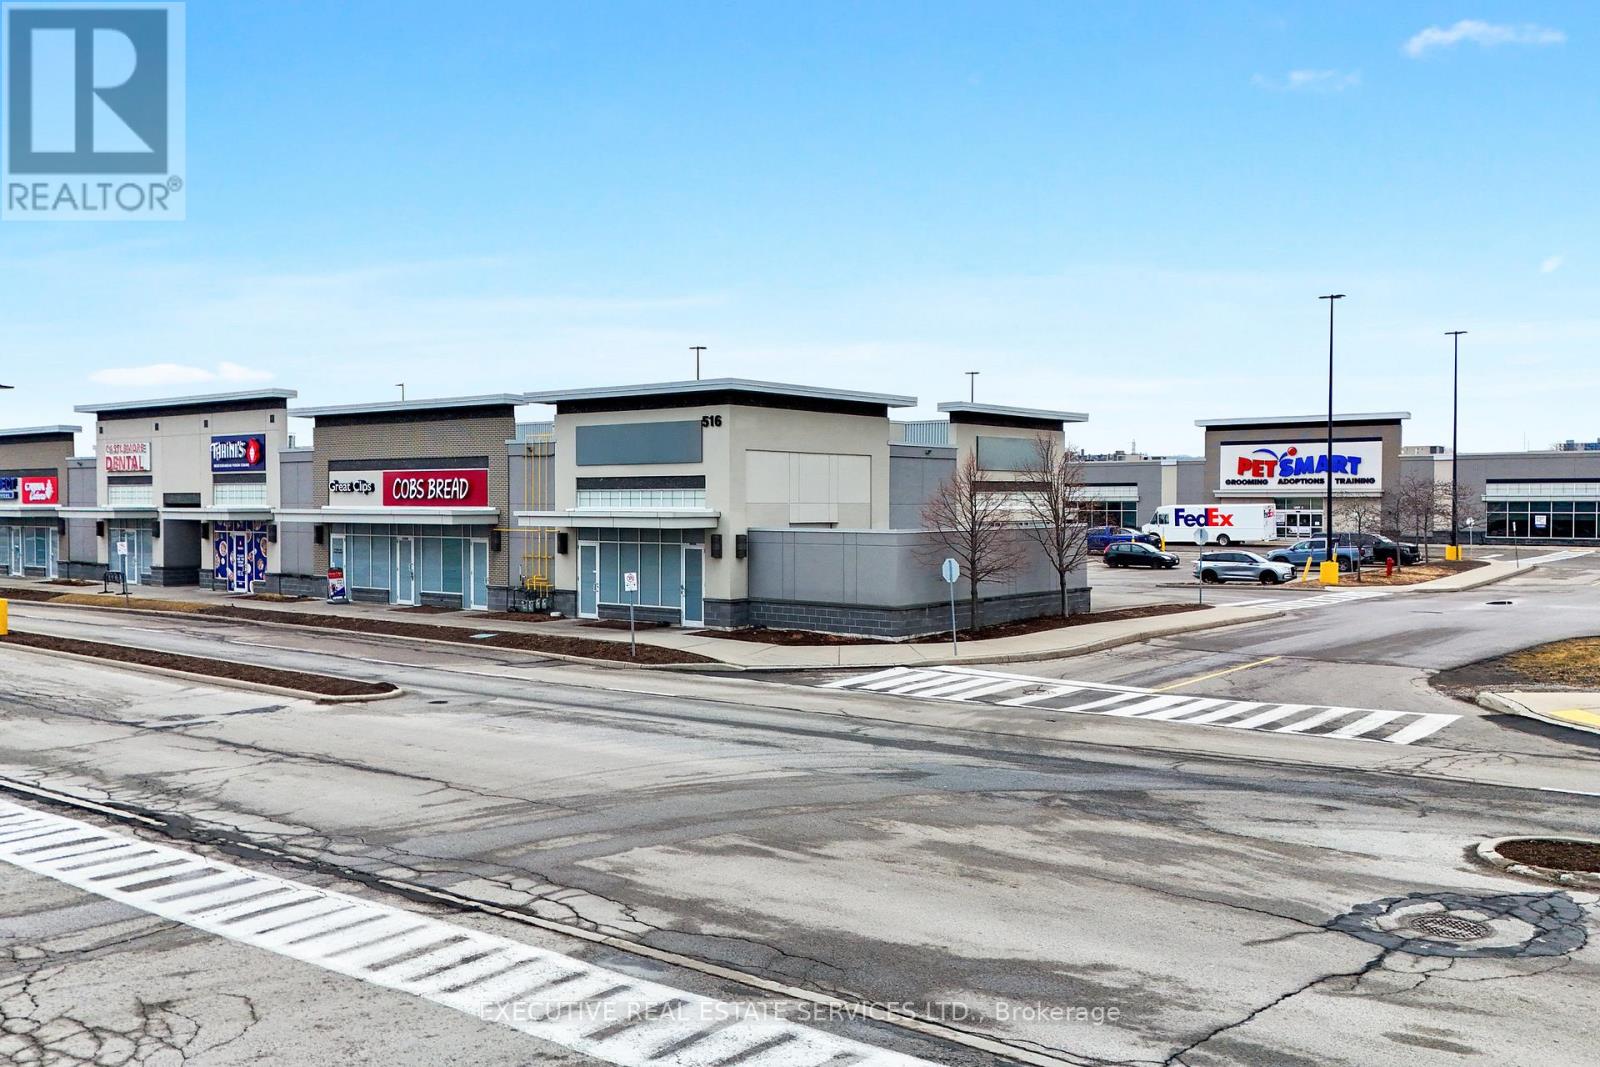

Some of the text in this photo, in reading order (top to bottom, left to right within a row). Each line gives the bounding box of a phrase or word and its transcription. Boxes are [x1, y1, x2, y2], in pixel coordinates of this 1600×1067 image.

[701, 415, 722, 428] 516
[105, 455, 145, 471] DENTAL
[329, 480, 373, 494] Great Clips
[392, 477, 469, 500] COBS BREAD
[1225, 477, 1376, 486] GROOMING ADOPTIONS TRAINING
[1174, 508, 1233, 527] FedEx
